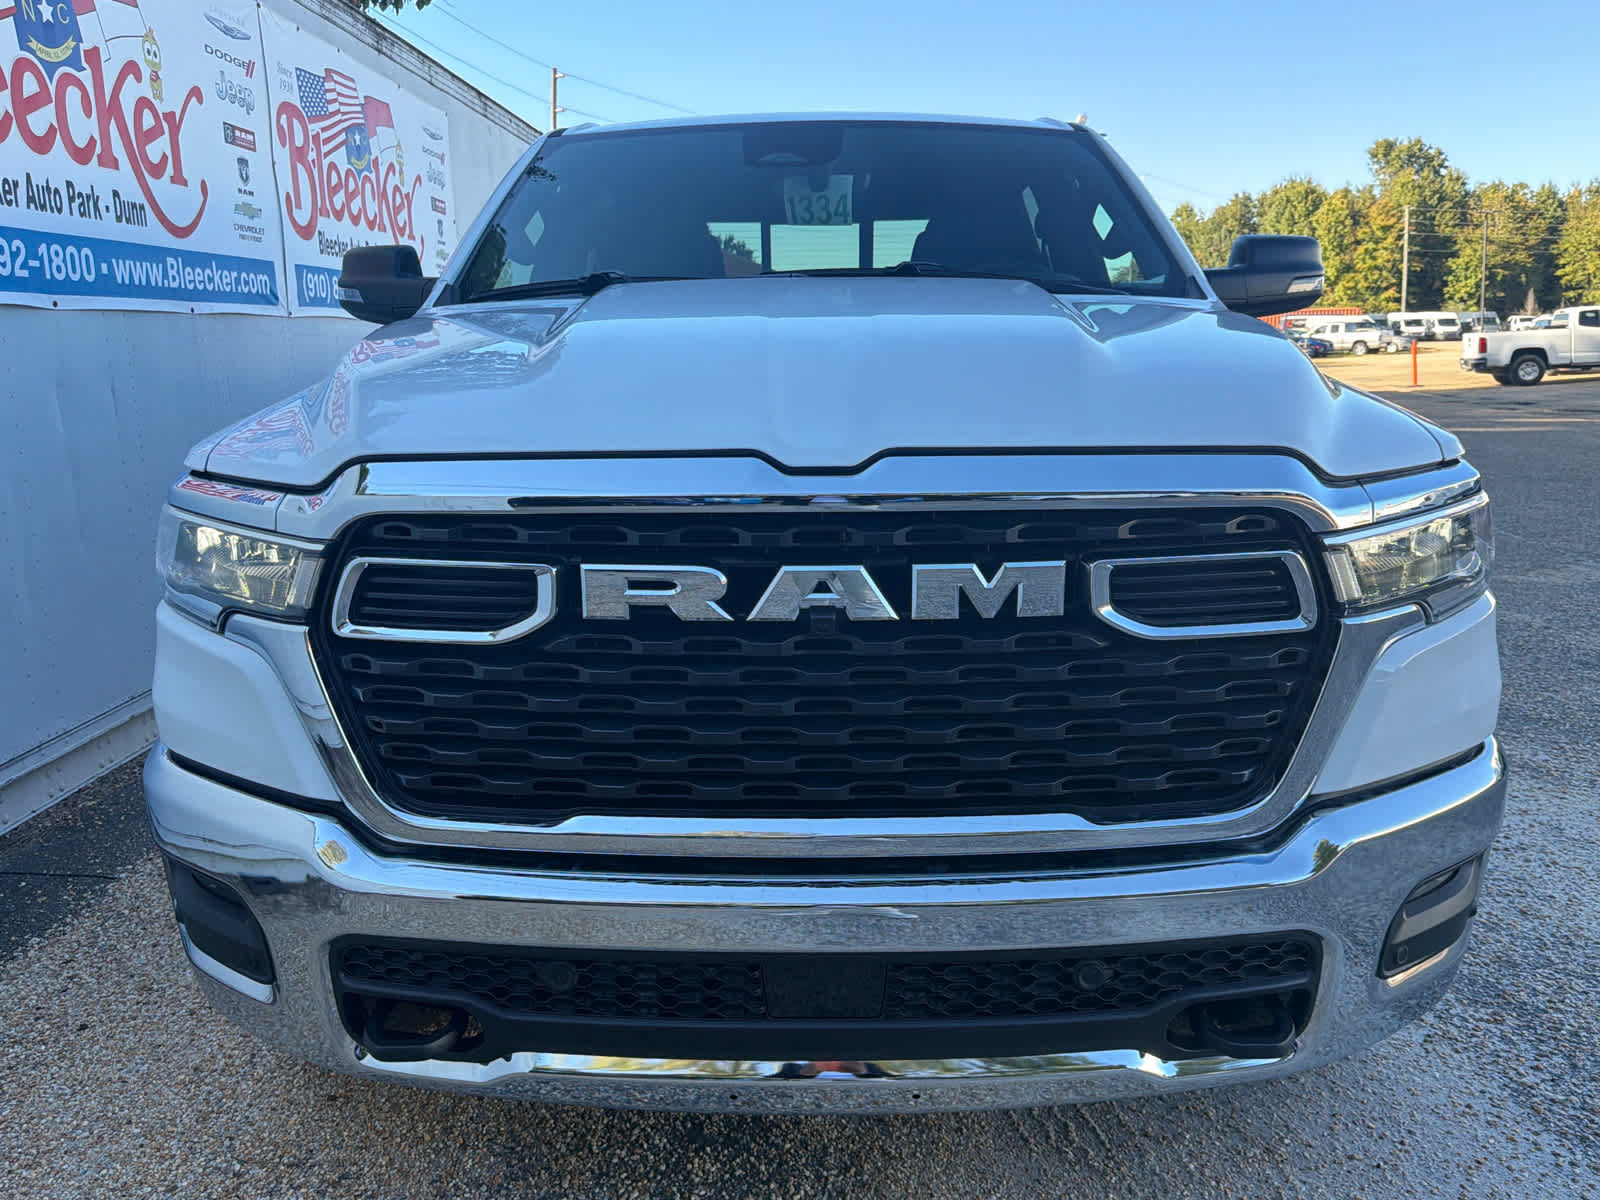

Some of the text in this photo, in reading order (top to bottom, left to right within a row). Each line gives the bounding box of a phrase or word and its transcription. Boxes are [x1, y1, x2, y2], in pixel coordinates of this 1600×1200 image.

[21, 0, 70, 24] N C
[204, 43, 250, 71] DODGE
[215, 70, 255, 116] Jeep
[25, 171, 63, 215] Auto
[65, 179, 103, 221] Park
[111, 188, 148, 228] Dunn
[276, 101, 425, 262] Bleecker
[786, 193, 850, 226] 1334
[112, 256, 271, 297] www.Bleecker.com
[303, 268, 331, 304] (910)
[580, 560, 1066, 621] RAM
